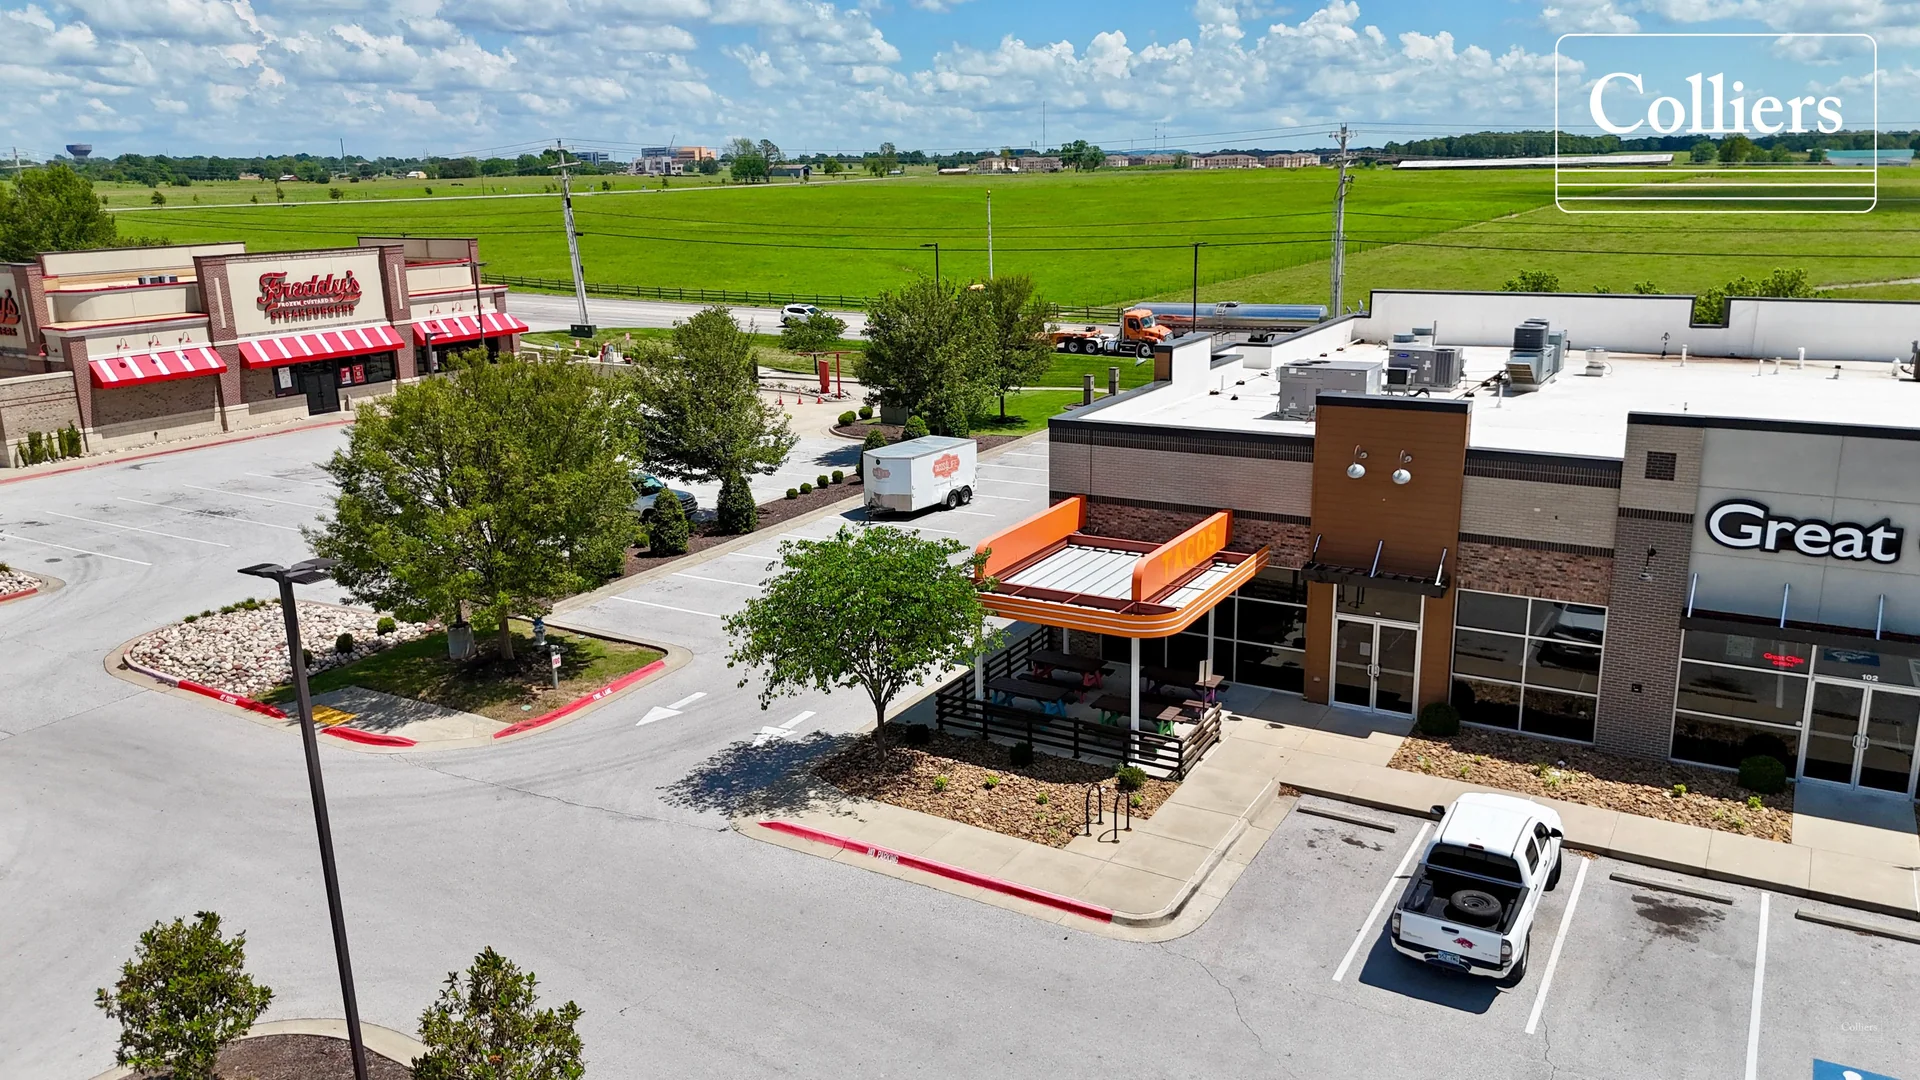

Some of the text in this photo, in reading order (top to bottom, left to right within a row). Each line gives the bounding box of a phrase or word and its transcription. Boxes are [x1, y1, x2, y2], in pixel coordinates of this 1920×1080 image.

[257, 270, 362, 305] Freddy's
[270, 304, 355, 320] STEAKBURGERS
[1709, 503, 1897, 562] Great
[1161, 523, 1217, 580] TACOS
[1763, 652, 1804, 664] Great Clips
[1772, 660, 1794, 668] OPEN
